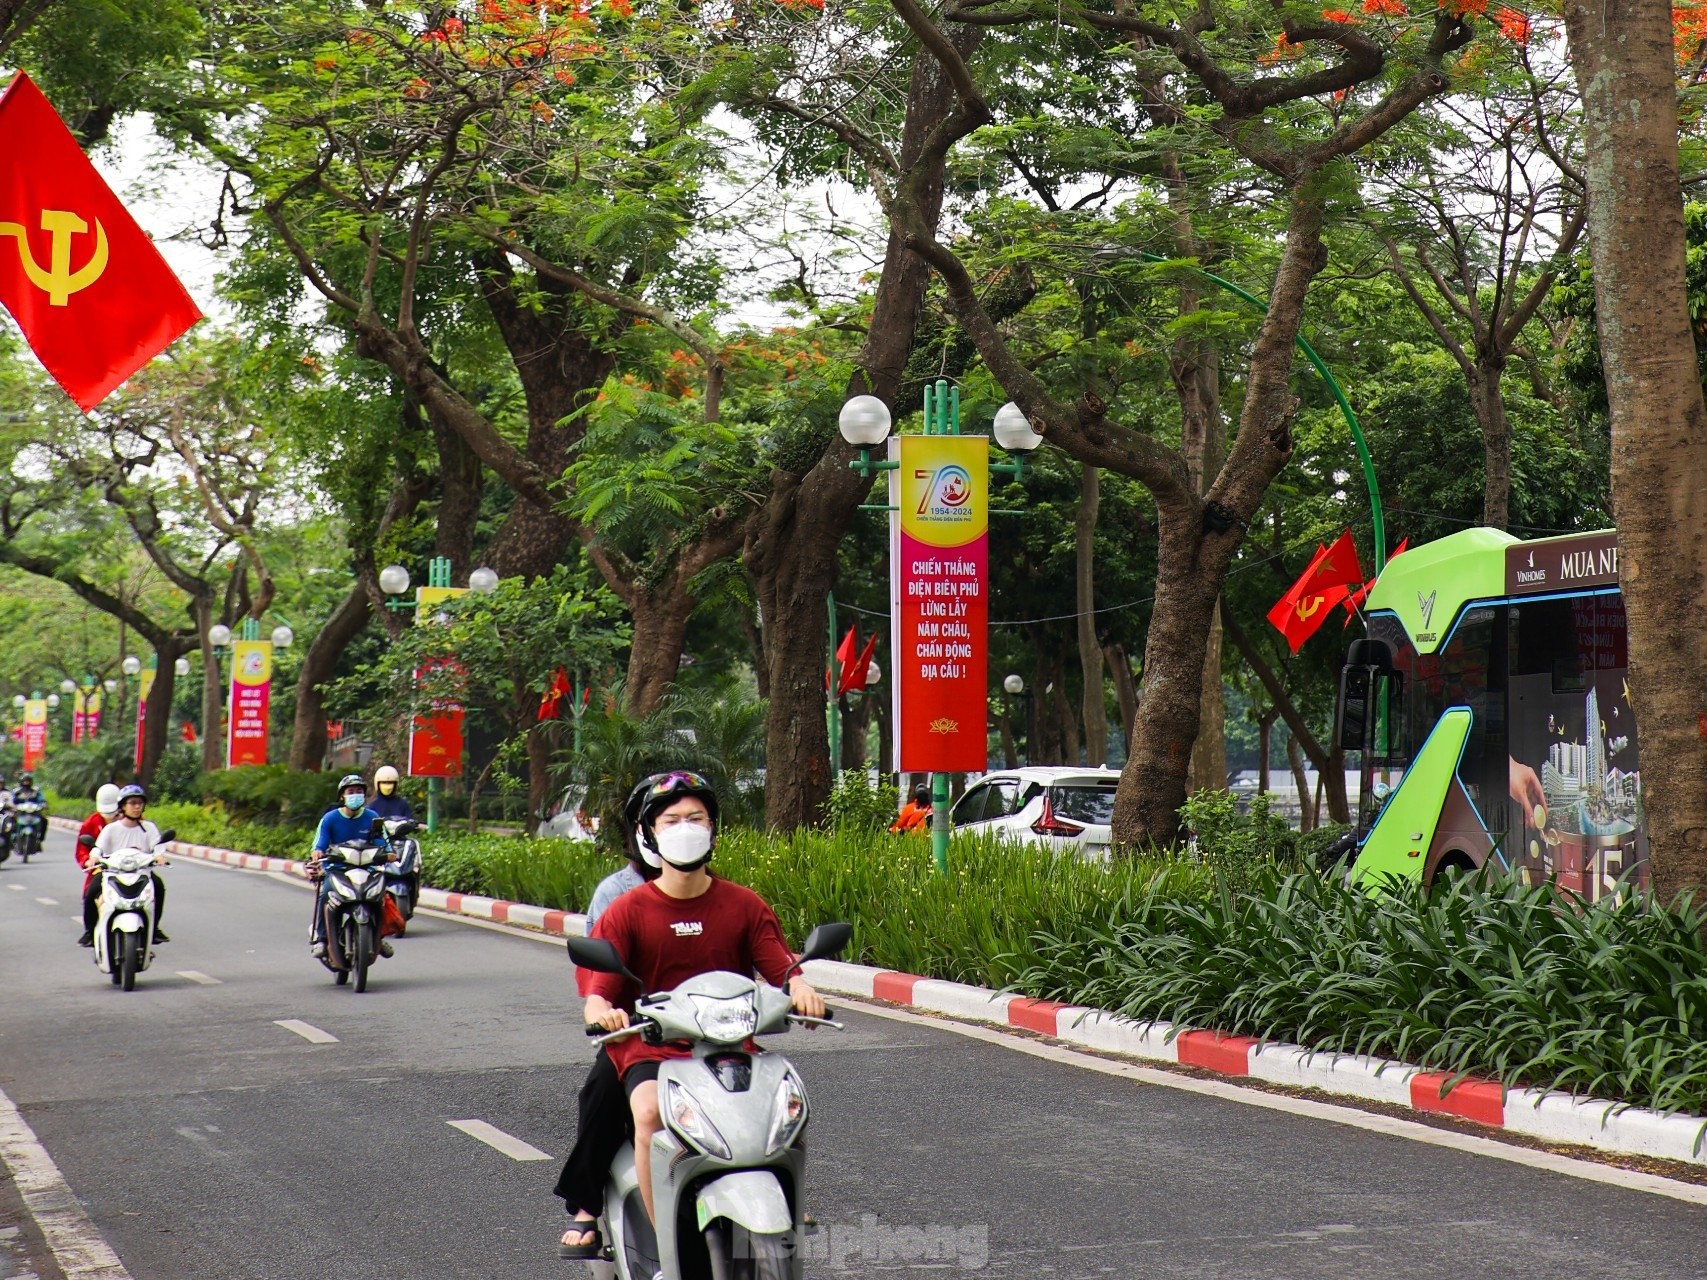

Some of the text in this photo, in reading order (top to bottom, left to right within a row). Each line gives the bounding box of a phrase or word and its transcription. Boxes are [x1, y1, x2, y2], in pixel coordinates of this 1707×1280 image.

[930, 507, 972, 515] 1954-2024
[912, 556, 976, 576] CHIẾN THẮNG
[1560, 550, 1597, 579] MUA
[1517, 570, 1545, 582] VINHOMES
[908, 578, 979, 598] ĐIỆN BIÊN PHỦ
[921, 596, 967, 617] LỪNG LẪY
[917, 620, 970, 639] NĂM CHÂU,
[1416, 633, 1436, 642] VINBUS
[916, 639, 972, 660] CHẤN ĐỘNG
[921, 659, 966, 681] ĐỊA CẦU !
